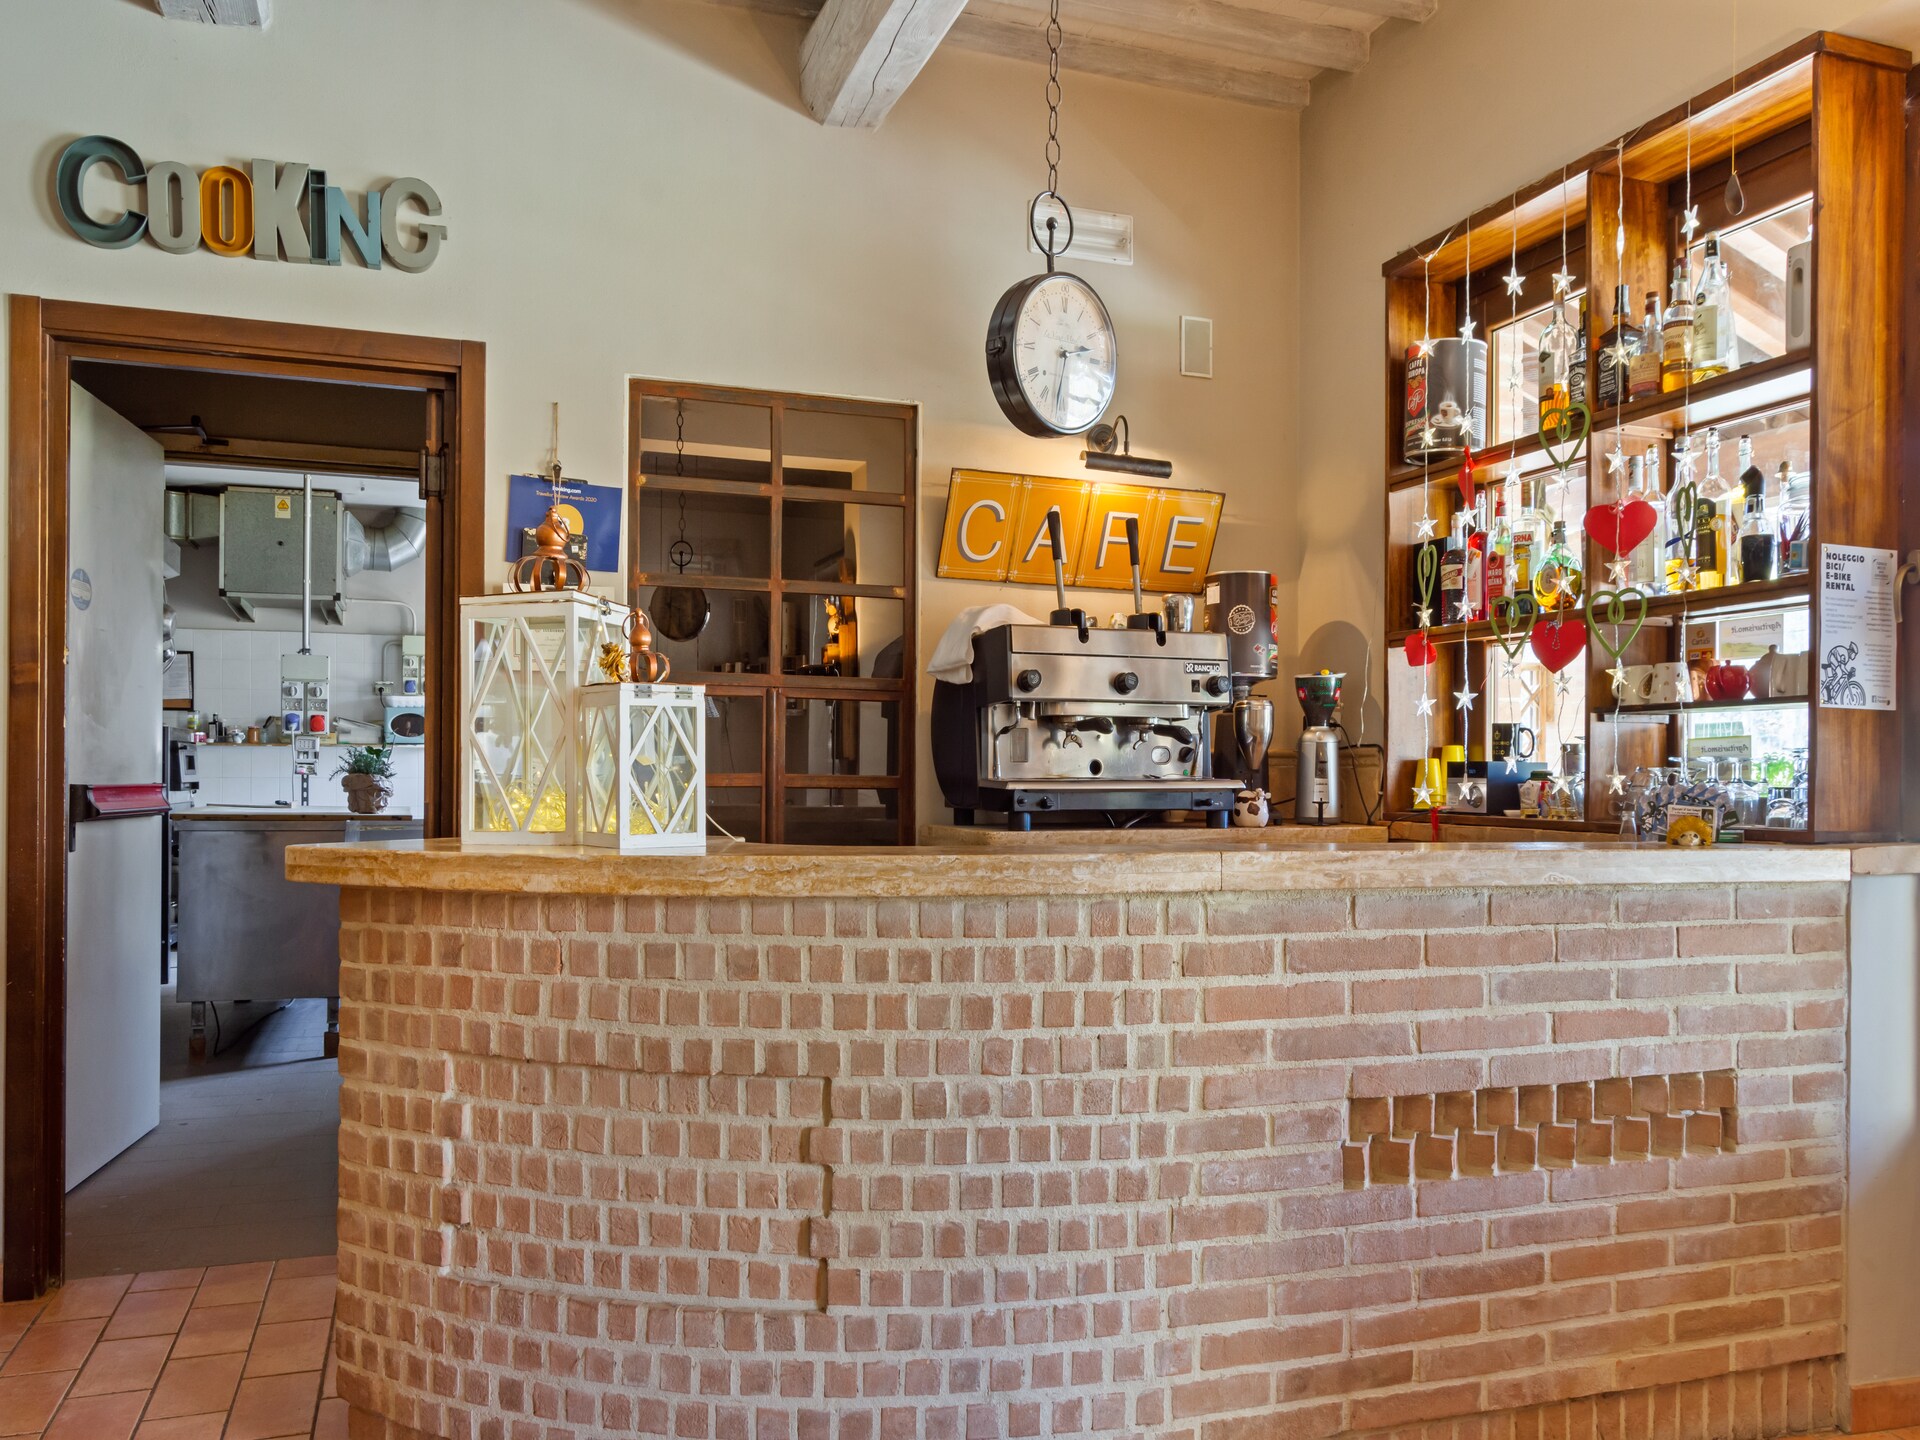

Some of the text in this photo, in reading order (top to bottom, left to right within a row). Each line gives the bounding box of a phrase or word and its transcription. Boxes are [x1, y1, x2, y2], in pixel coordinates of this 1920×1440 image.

[957, 498, 1205, 574] CAFE
[1825, 552, 1865, 563] NOLEGGIO
[1825, 562, 1845, 572] BICI/
[1825, 572, 1852, 582] E-BIKE
[1825, 581, 1856, 592] RENTAL
